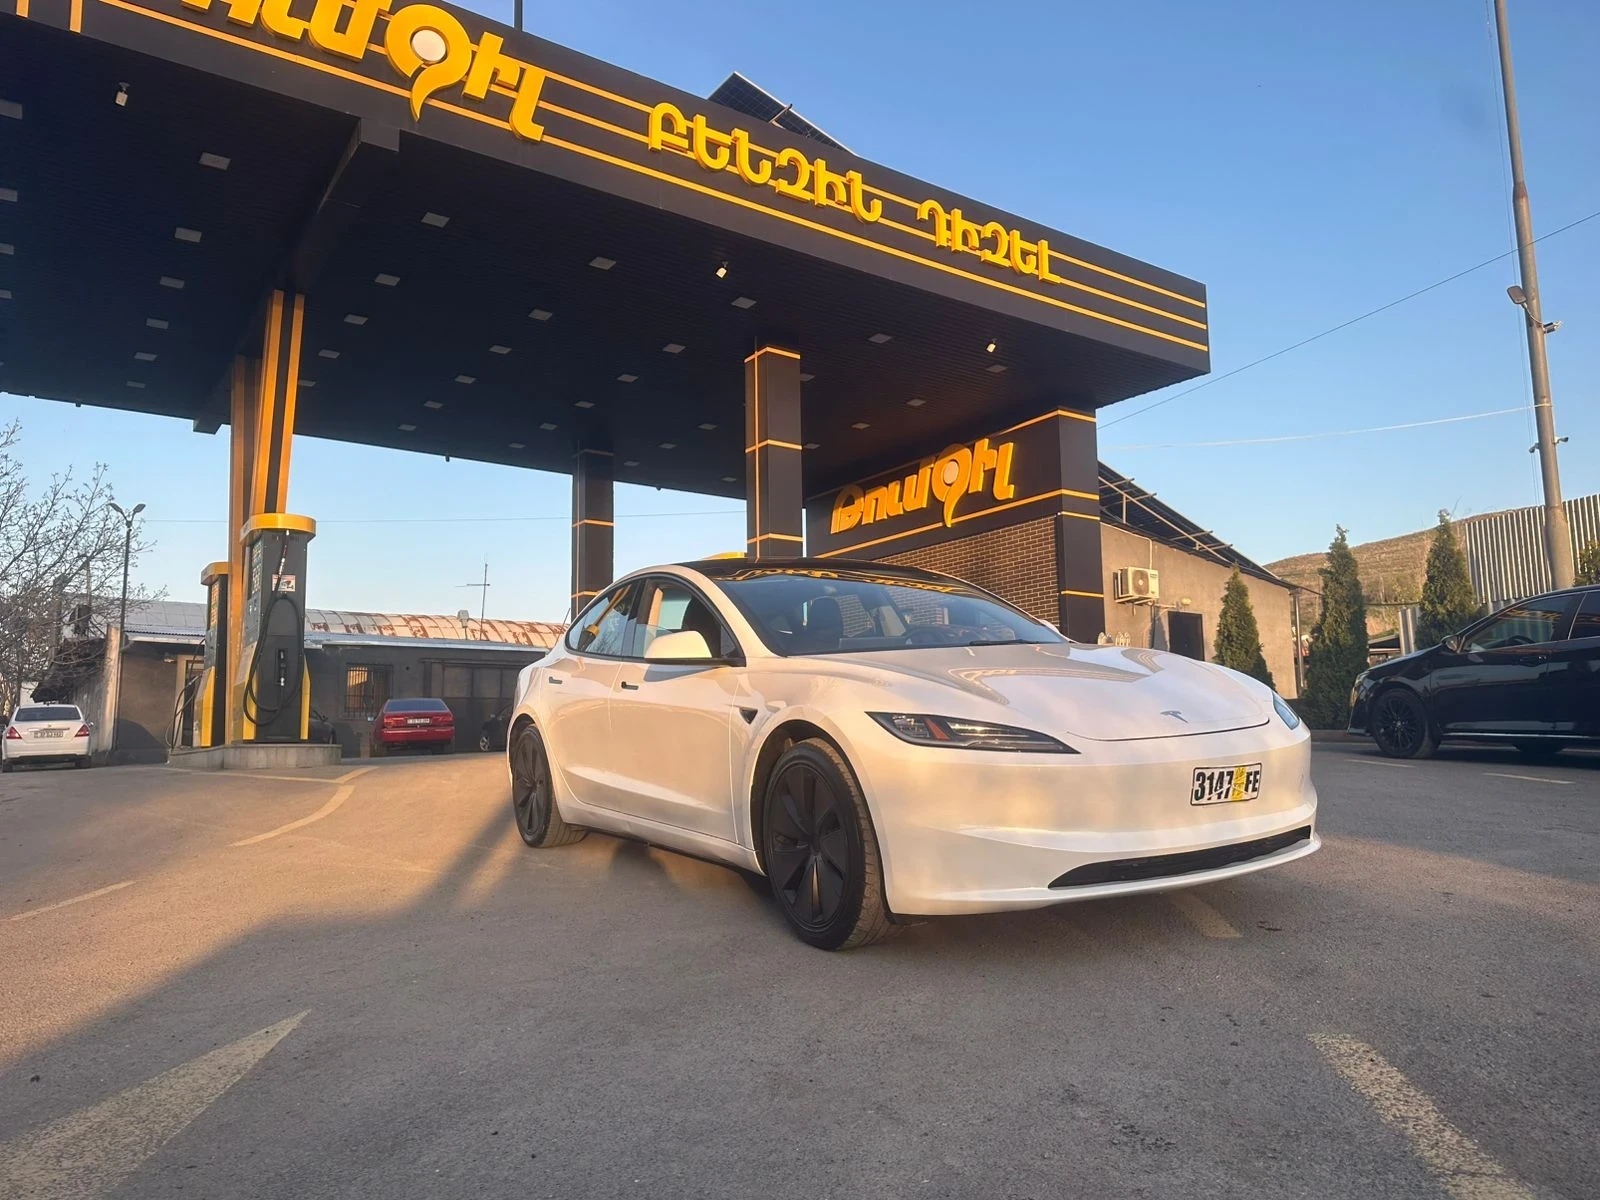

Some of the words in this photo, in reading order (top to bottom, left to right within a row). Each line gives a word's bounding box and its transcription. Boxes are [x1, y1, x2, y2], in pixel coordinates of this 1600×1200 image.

[648, 102, 882, 224] ԲԵՆԶԻՆ
[916, 199, 1061, 285] ԴԻԶԵԼ
[1194, 770, 1234, 801] 3147
